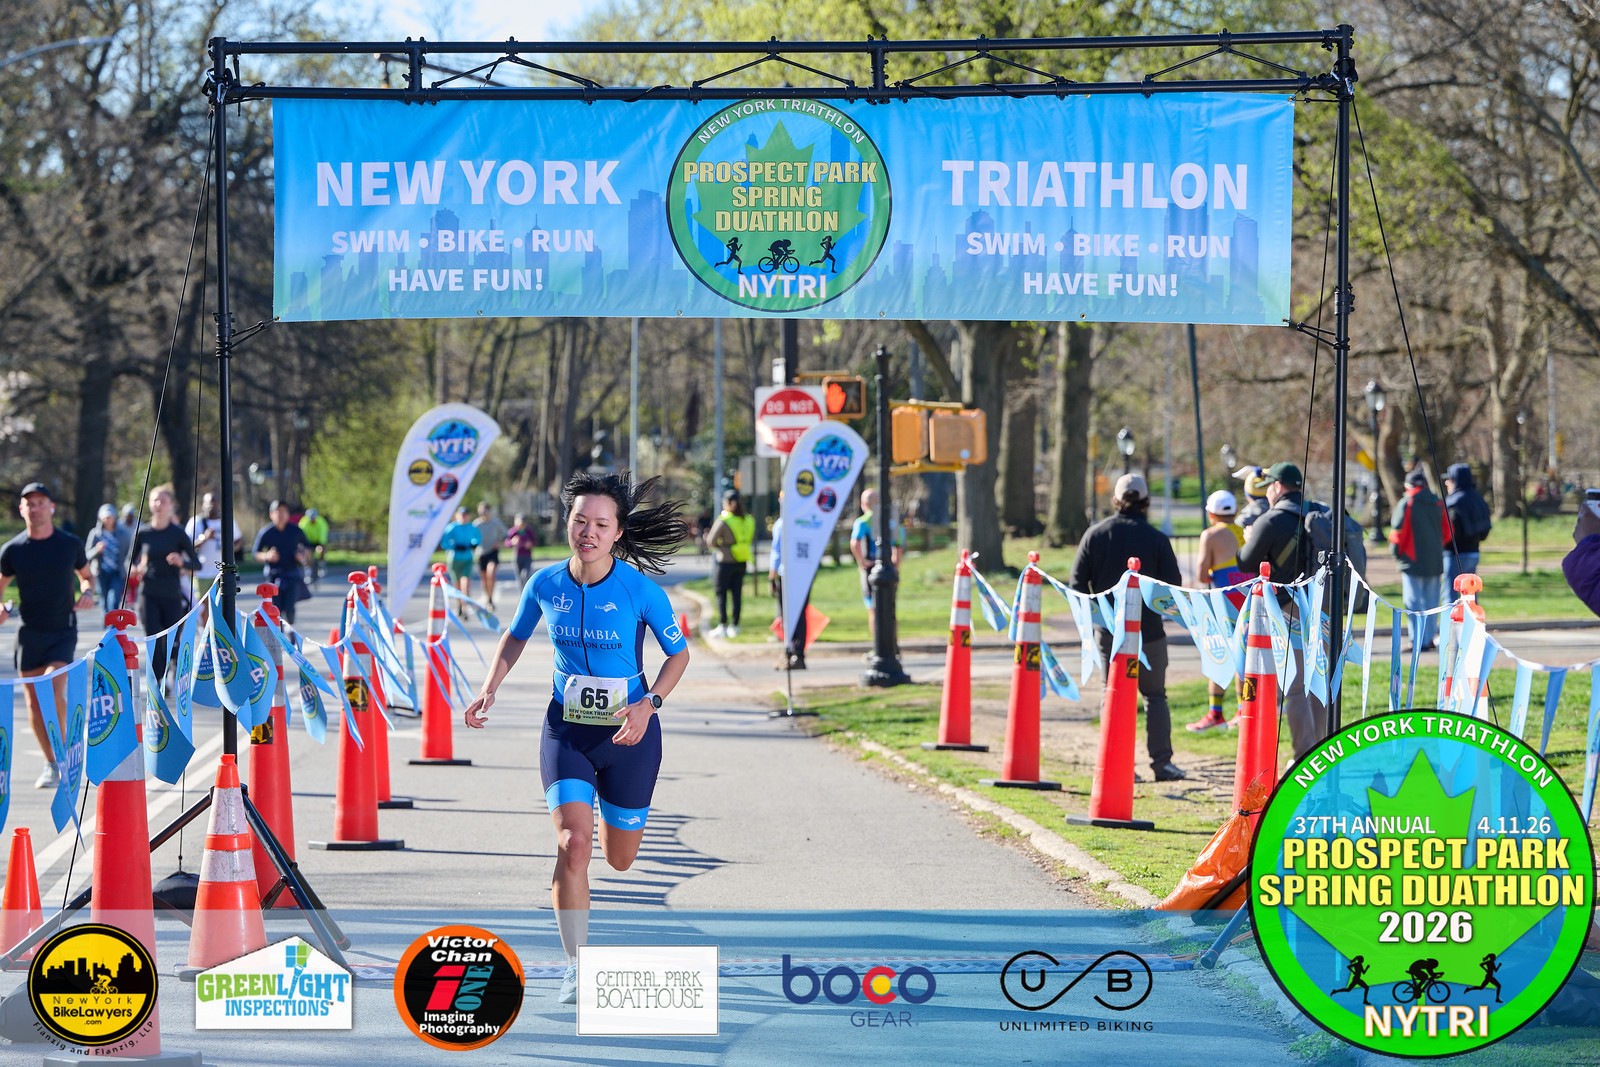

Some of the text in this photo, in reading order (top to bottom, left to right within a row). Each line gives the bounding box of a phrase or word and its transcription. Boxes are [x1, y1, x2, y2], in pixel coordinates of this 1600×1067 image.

[697, 98, 865, 144] NEW YORK TRIATHLON
[317, 159, 622, 206] NEW YORK
[683, 161, 878, 183] PROSPECT PARK
[942, 160, 1248, 210] TRIATHLON
[731, 186, 823, 208] SPRING
[715, 210, 840, 232] DUATHLON
[331, 229, 595, 253] SWIM BIKE RUN
[966, 231, 1230, 259] SWIM BIKE RUN
[388, 268, 544, 292] HAVE FUN!
[738, 274, 827, 299] NYTRI
[1023, 271, 1178, 297] HAVE FUN!
[766, 400, 814, 414] DO NOT
[428, 437, 477, 455] NYTR
[548, 623, 620, 641] COLUMBIA
[551, 637, 623, 650] TRIATHLON CLUB
[580, 687, 609, 710] 65
